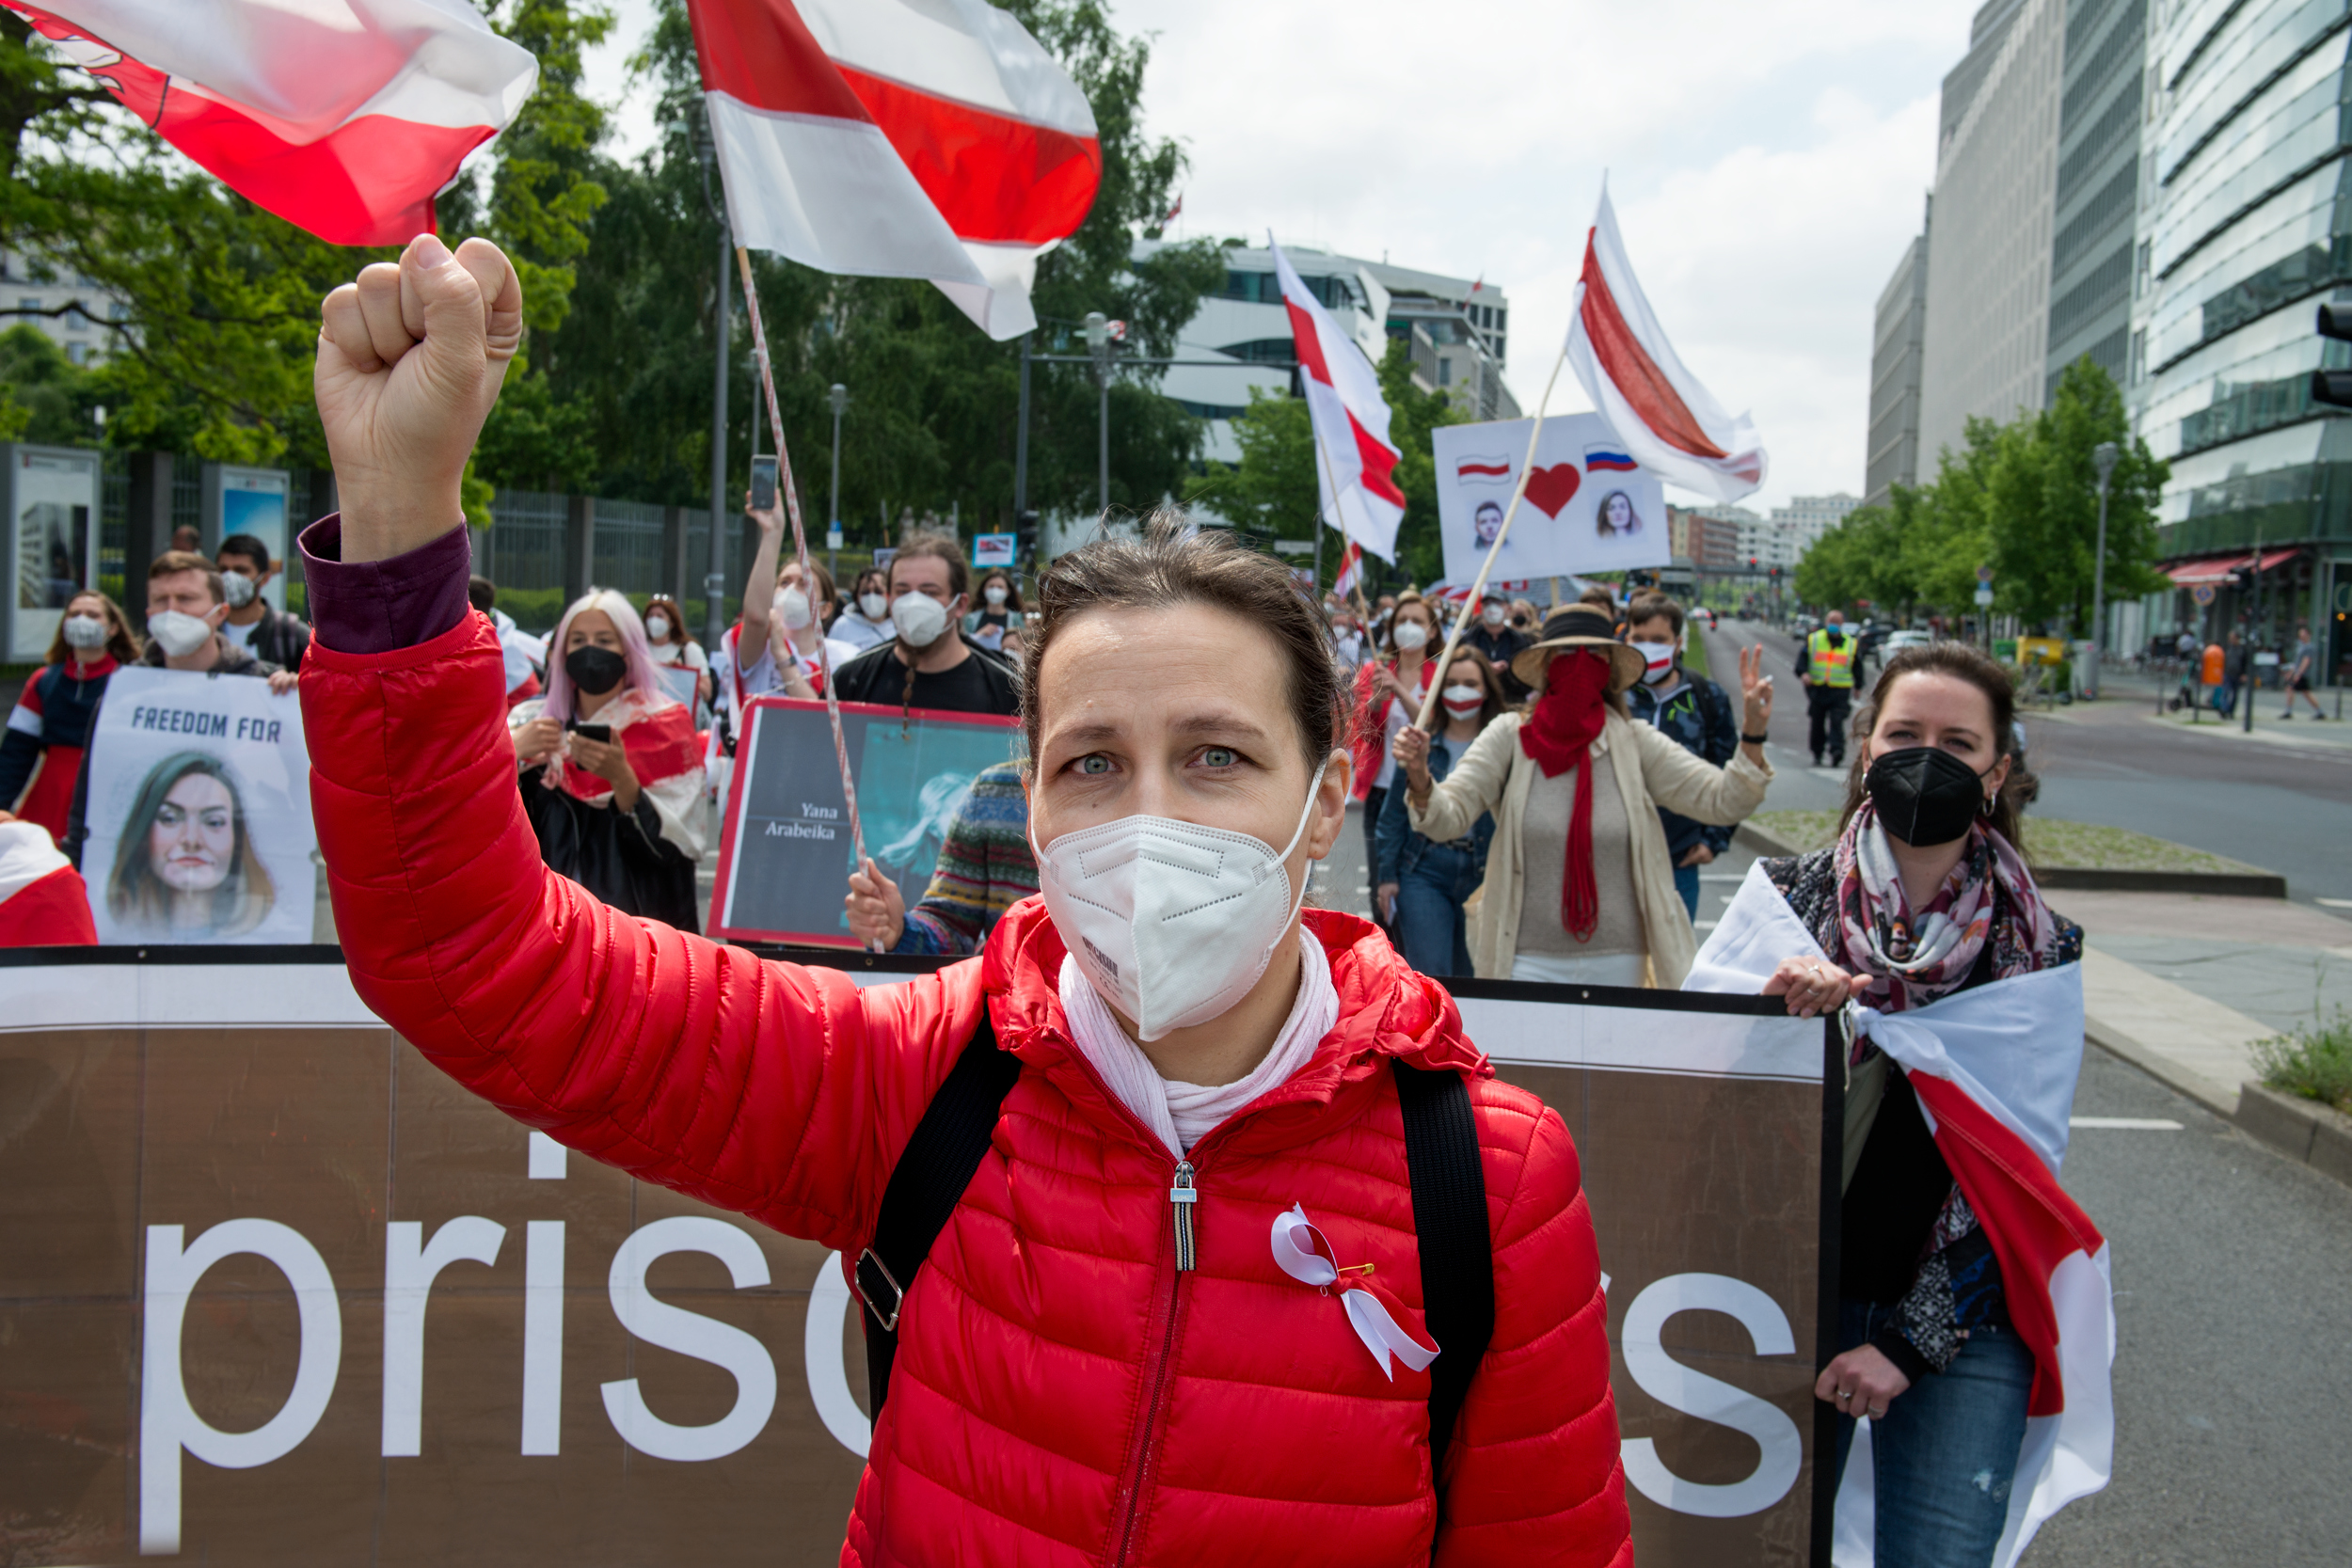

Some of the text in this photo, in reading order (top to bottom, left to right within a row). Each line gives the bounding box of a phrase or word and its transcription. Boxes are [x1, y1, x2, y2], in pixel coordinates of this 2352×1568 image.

[131, 705, 281, 743] FREEDOM FOR
[802, 802, 838, 819] Yana
[765, 820, 835, 840] Arabeika
[139, 1131, 1803, 1555] priss
